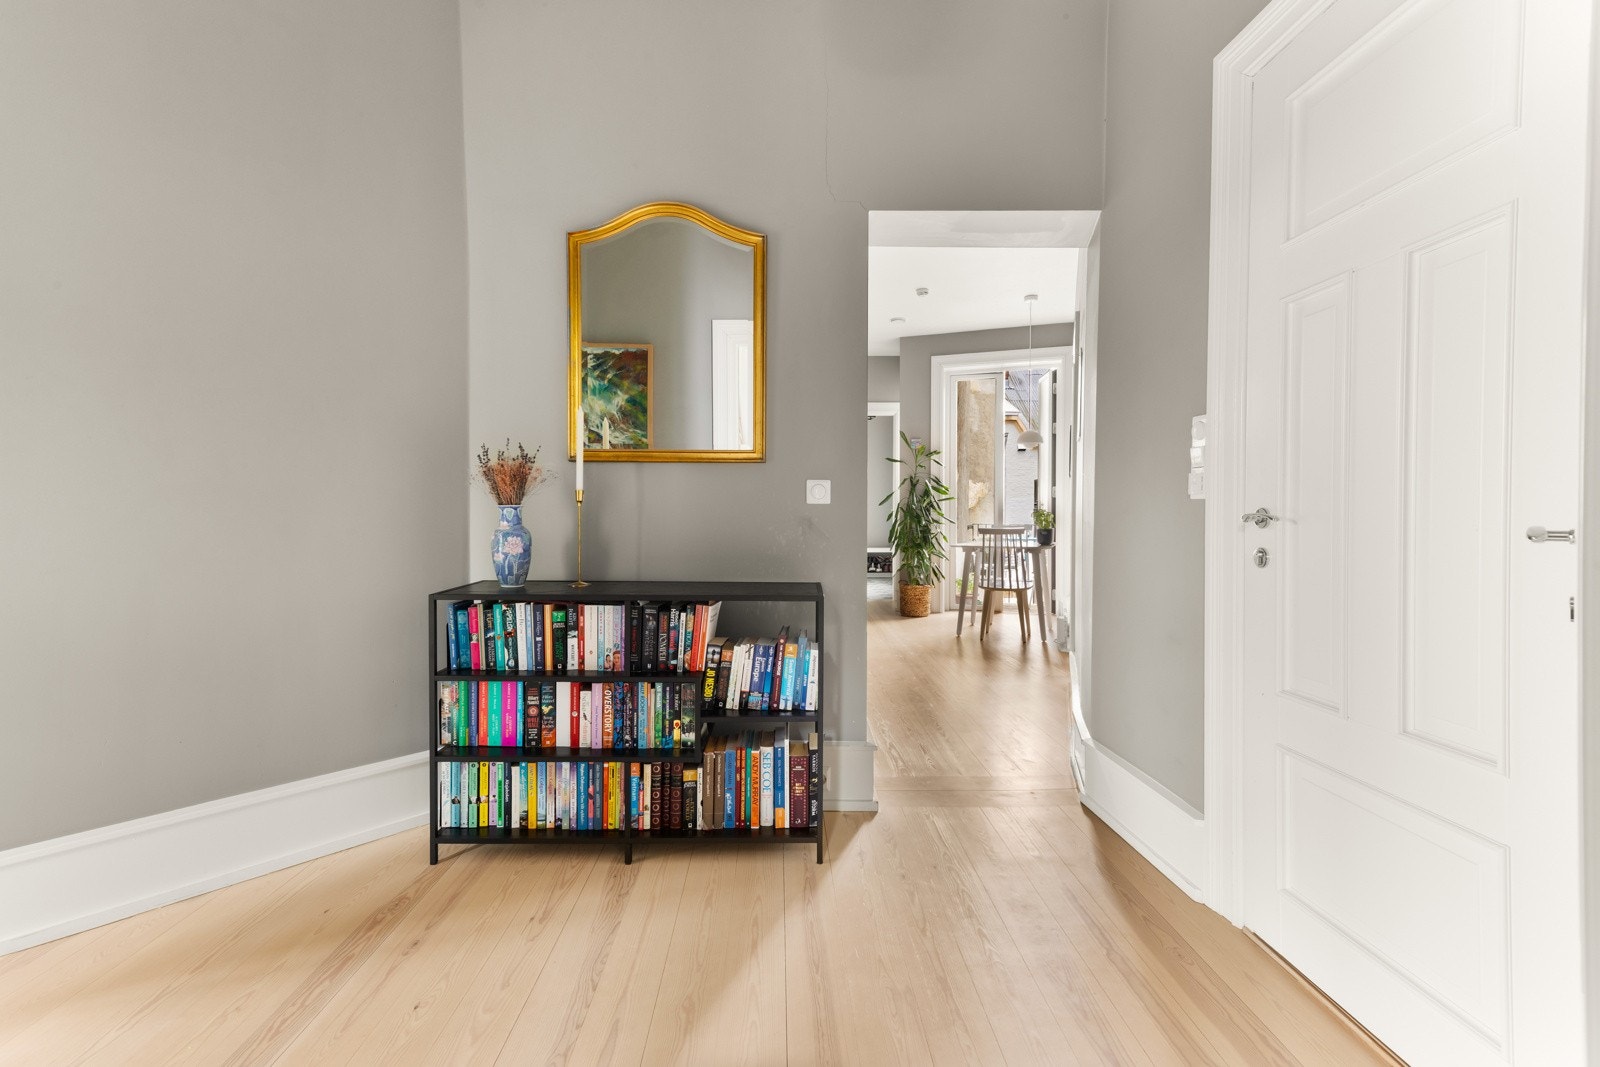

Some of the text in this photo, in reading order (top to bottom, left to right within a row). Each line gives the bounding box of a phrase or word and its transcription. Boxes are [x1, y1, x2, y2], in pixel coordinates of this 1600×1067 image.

[753, 656, 762, 682] Europe
[762, 752, 772, 793] SEB COE
